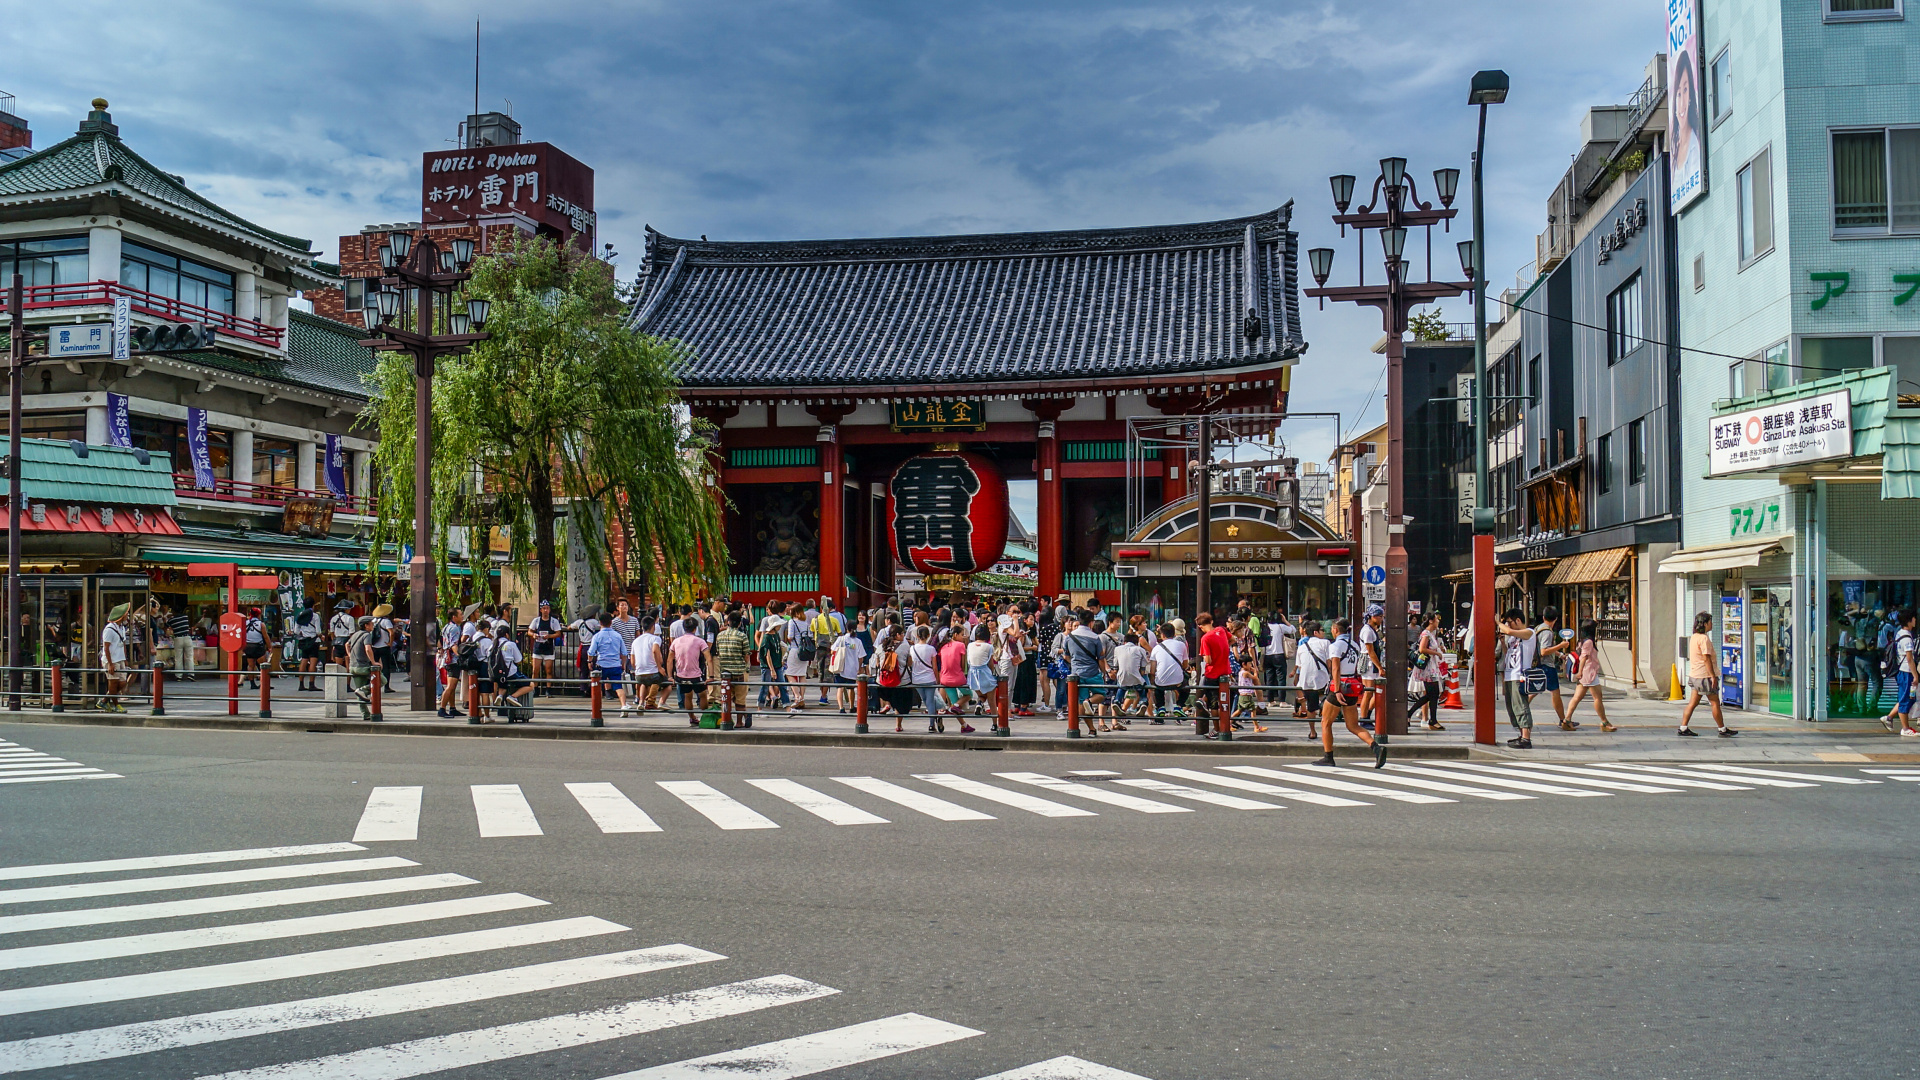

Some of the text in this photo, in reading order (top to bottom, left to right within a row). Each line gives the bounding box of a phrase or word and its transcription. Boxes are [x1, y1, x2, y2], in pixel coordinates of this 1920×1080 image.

[1670, 7, 1691, 57] No.1
[431, 152, 537, 173] HOTEL Ryokan
[60, 328, 101, 343] 雷門
[116, 299, 127, 358] スクランブル式
[60, 344, 100, 352] Kaminarimon
[1763, 403, 1833, 431] 銀座線 浅草駅
[1714, 421, 1742, 440] 地下鉄
[1762, 418, 1847, 442] Ginza Line Asakusa Sta.
[1715, 437, 1741, 450] SUBWAY
[891, 455, 981, 573] 雷門
[1460, 490, 1474, 519] 三定
[1731, 502, 1779, 536] アオノヤ
[1227, 546, 1282, 559] 雷門交番
[1190, 565, 1276, 573] KNARIMON KOBAN
